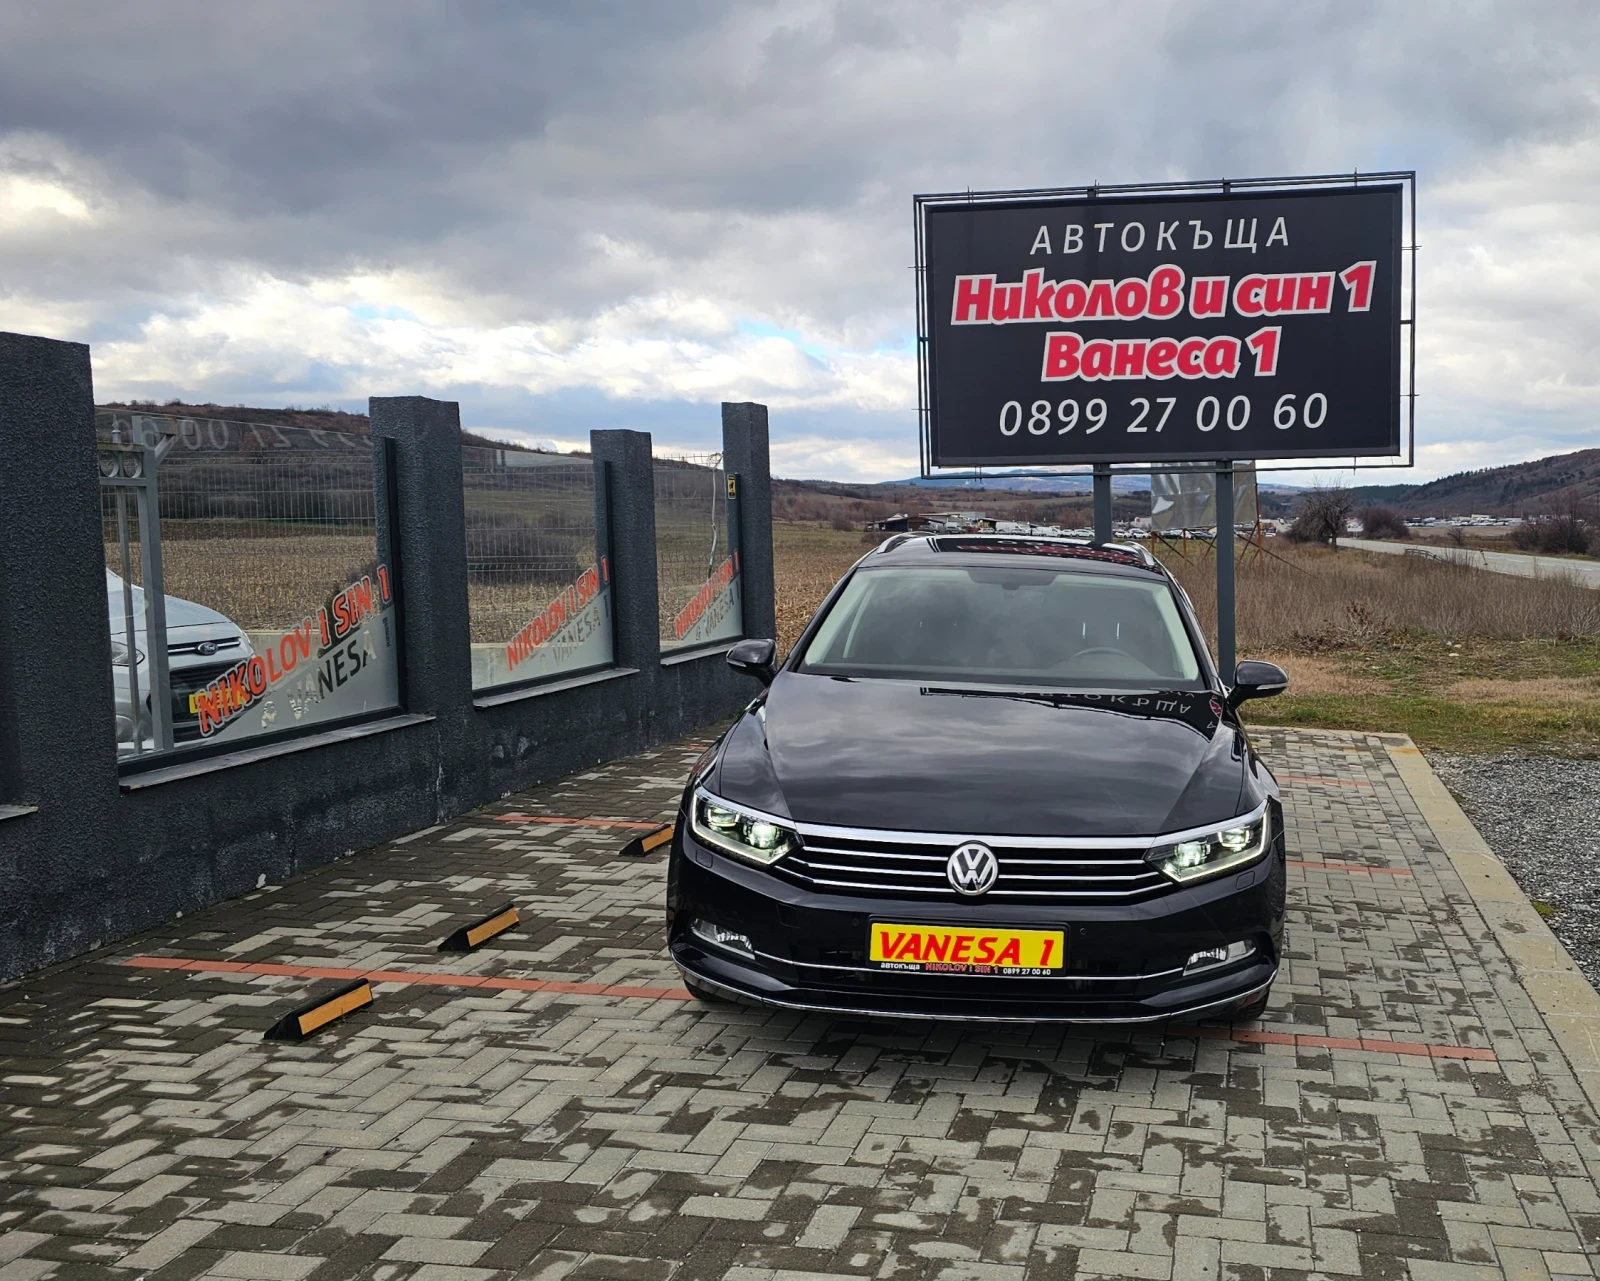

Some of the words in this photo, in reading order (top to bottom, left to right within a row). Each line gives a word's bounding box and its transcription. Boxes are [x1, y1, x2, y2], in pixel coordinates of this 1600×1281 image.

[1030, 216, 1289, 254] АВТОКЪЩА
[951, 263, 1185, 325] Николов
[1189, 276, 1230, 319] и
[1233, 271, 1336, 318] син
[1339, 260, 1377, 312] 1
[1041, 331, 1242, 382] Ванеса
[1246, 326, 1282, 376] 1
[999, 399, 1108, 436] 0899
[1127, 397, 1177, 433] 27
[1196, 395, 1251, 431] 00
[1273, 392, 1328, 430] 60
[506, 592, 566, 670] NIKOLOV
[568, 585, 576, 615] I
[577, 563, 599, 608] SIN
[601, 555, 609, 584] 1
[195, 617, 312, 736] NIKOLOV
[317, 606, 332, 648] I
[333, 575, 373, 636] SIN
[377, 564, 391, 603] 1
[287, 630, 377, 720] VANESA
[880, 931, 1021, 966] VANESA
[1039, 939, 1054, 966] 1
[880, 962, 920, 971] автокъща
[925, 962, 968, 972] NIKOLOV
[974, 964, 991, 973] SIN
[993, 965, 999, 974] 1
